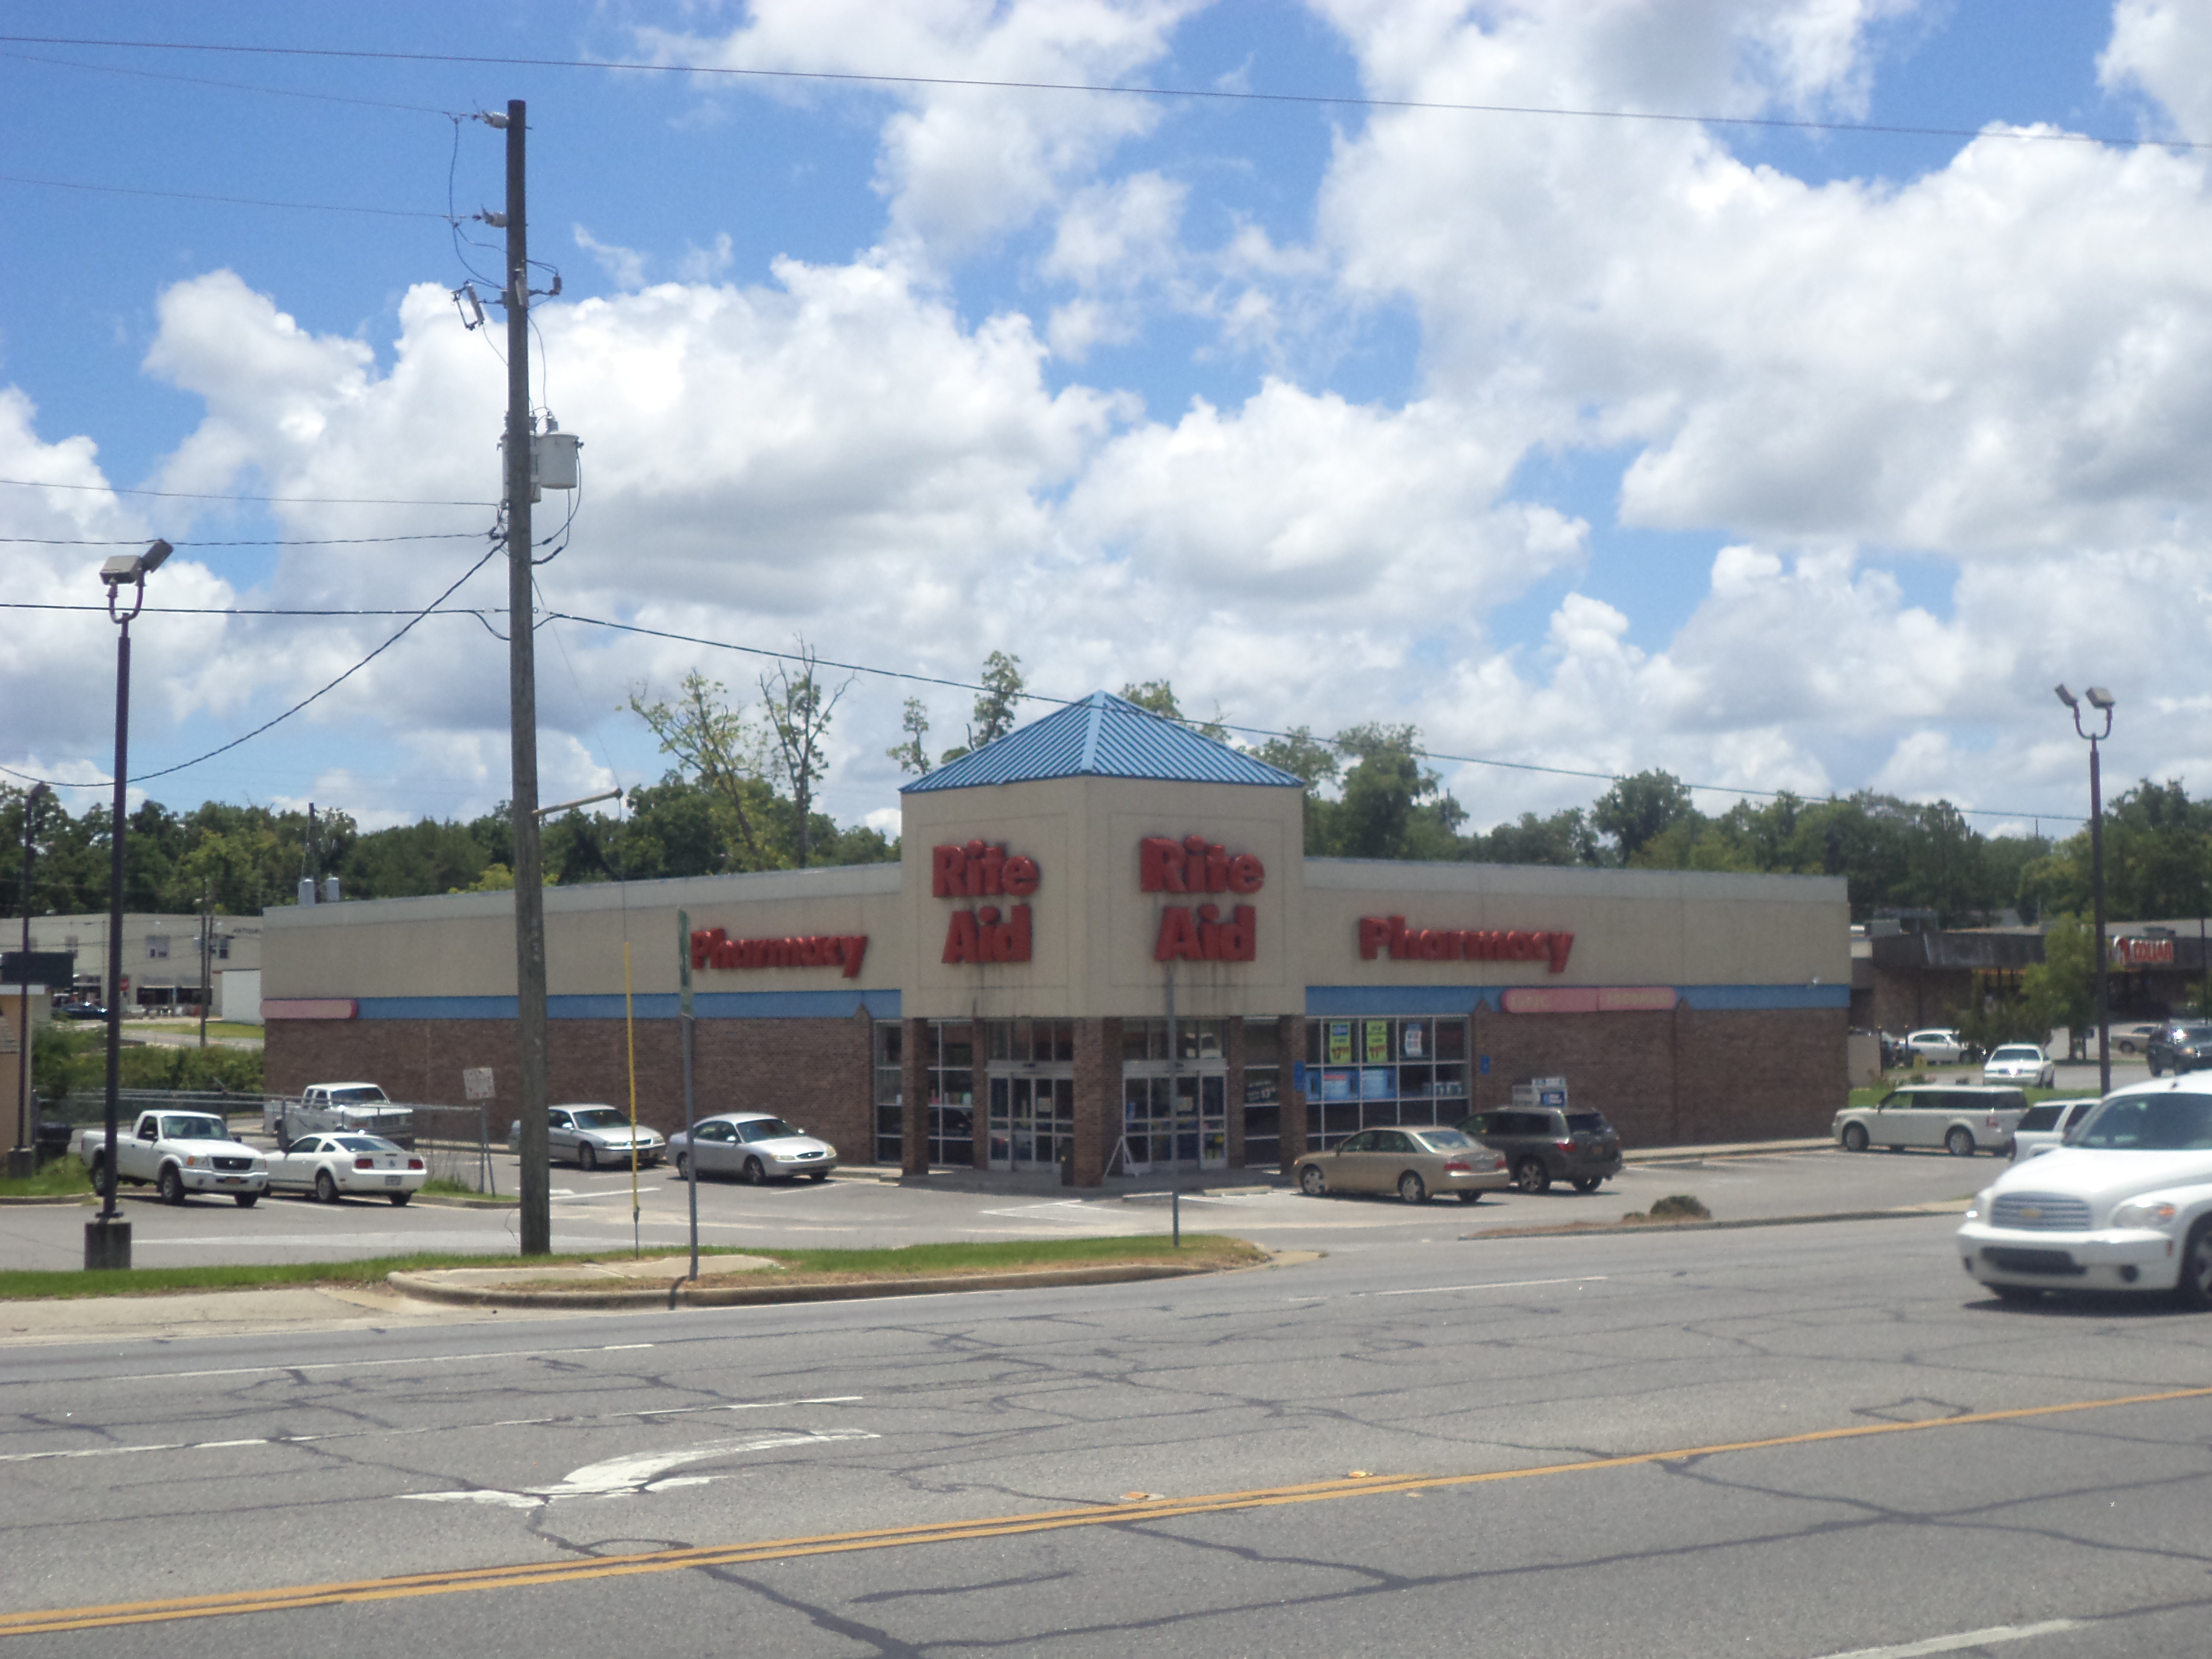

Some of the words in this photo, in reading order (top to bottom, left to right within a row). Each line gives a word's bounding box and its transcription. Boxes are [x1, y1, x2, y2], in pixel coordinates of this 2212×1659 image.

[932, 839, 1038, 898] Rite
[1141, 835, 1265, 894] Rite
[691, 927, 867, 977] Pharmacy
[942, 904, 1031, 963] Aid
[1155, 904, 1257, 961] Aid
[1359, 915, 1575, 973] Pharmacy
